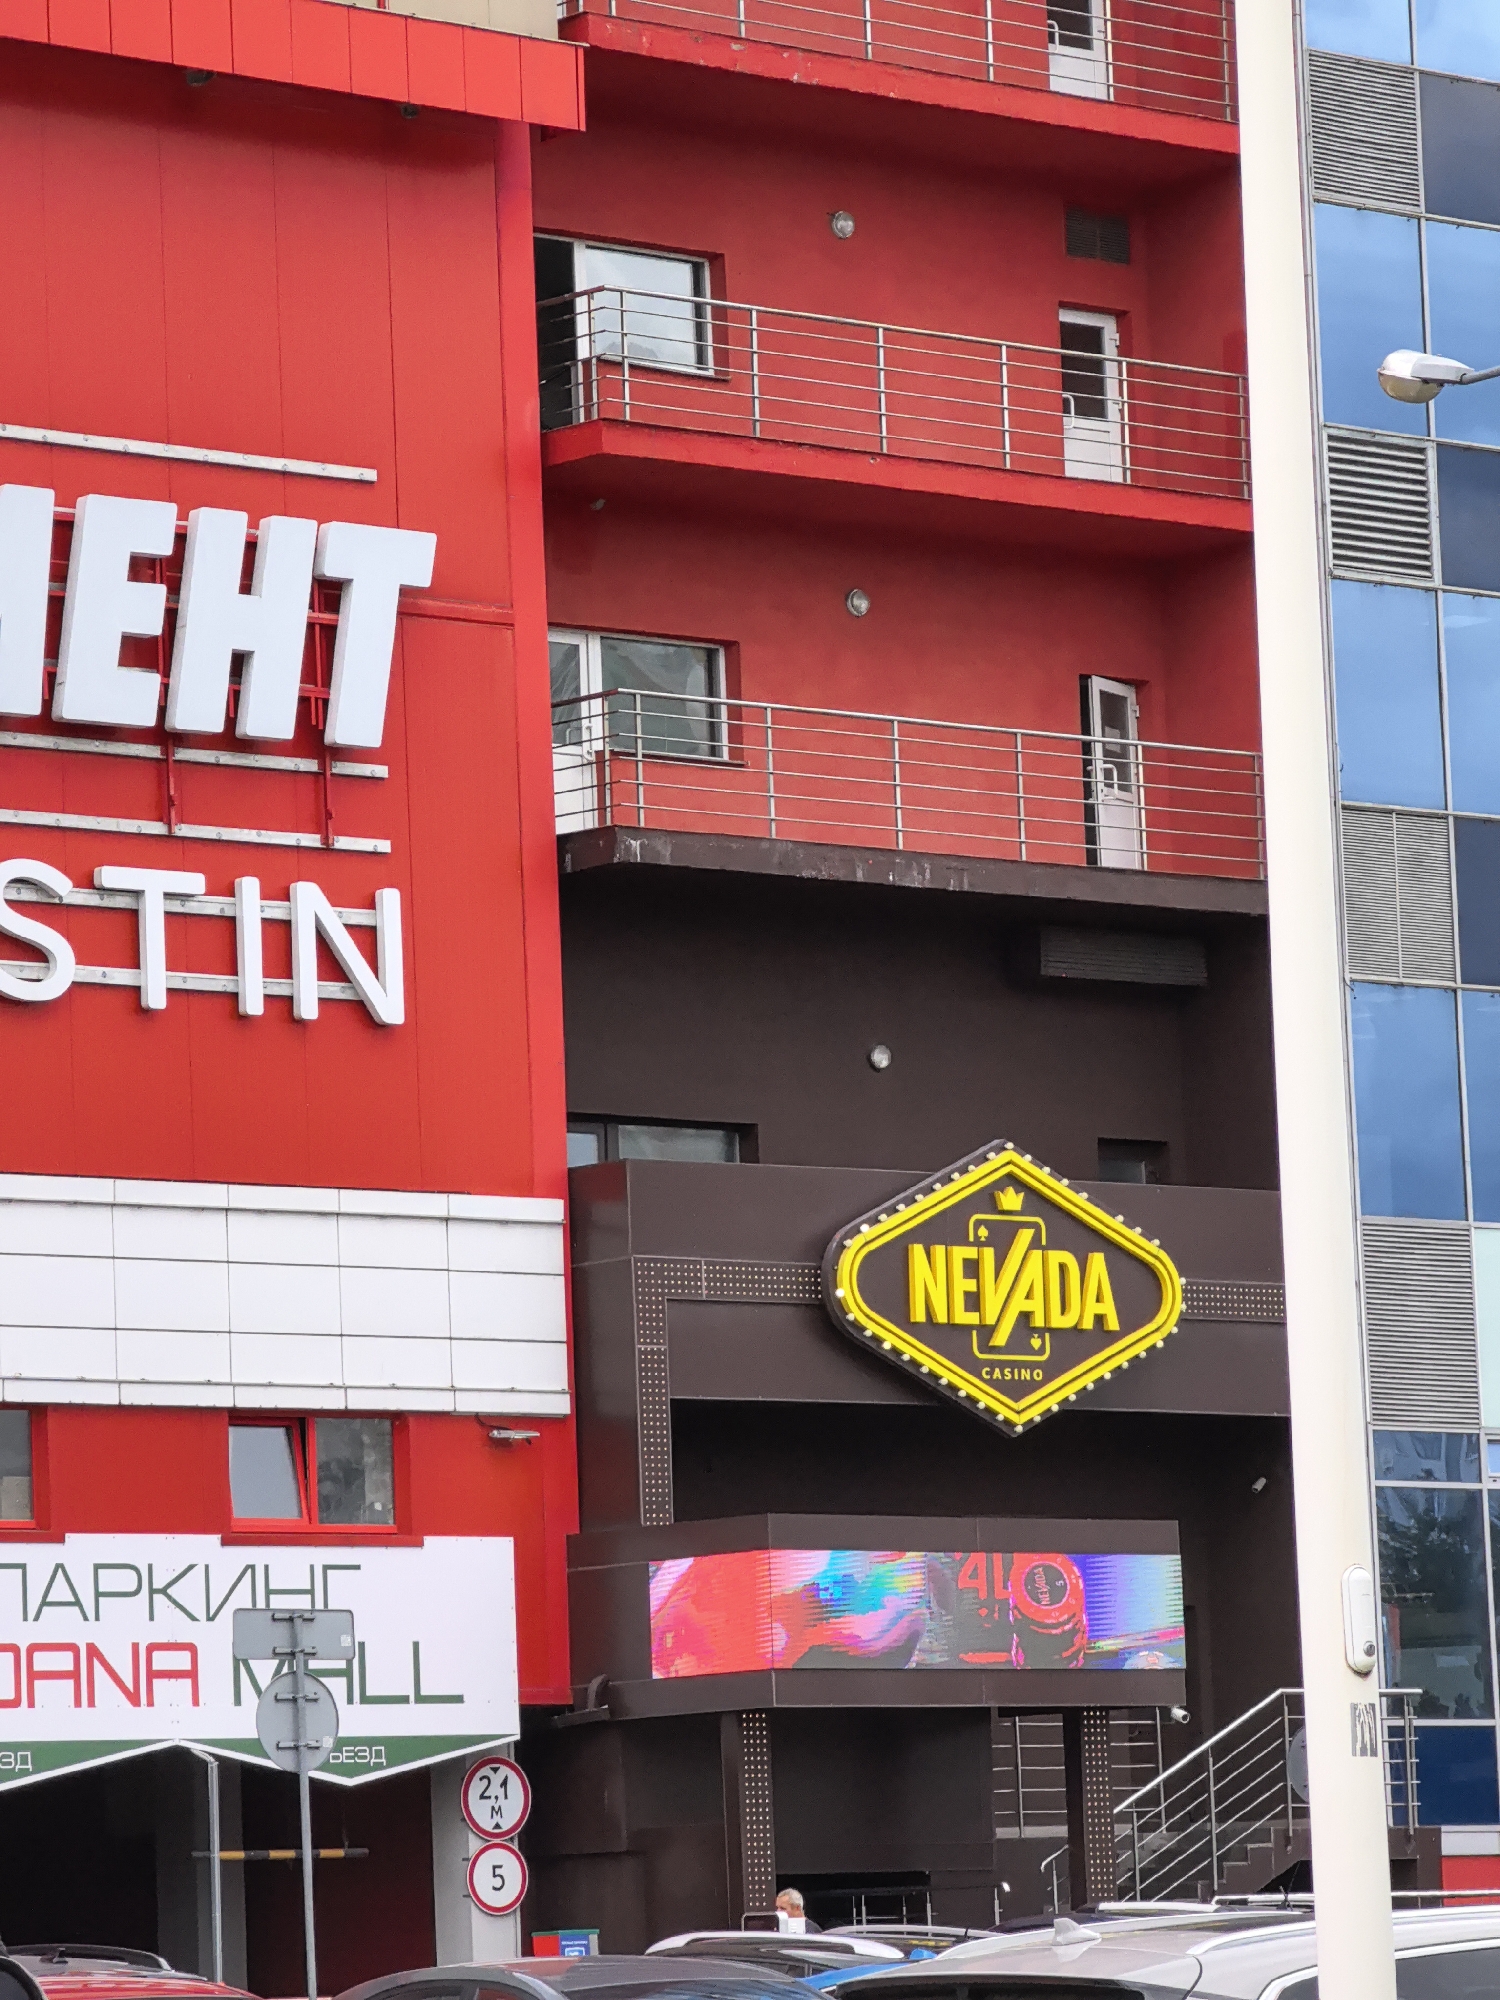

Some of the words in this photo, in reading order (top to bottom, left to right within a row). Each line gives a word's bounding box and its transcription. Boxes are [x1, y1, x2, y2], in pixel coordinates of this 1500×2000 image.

[0, 858, 405, 1025] STIN
[908, 1228, 1120, 1347] NEVADA
[981, 1366, 1043, 1381] CASINO
[479, 1774, 509, 1804] 2,1
[491, 1864, 506, 1892] 5
